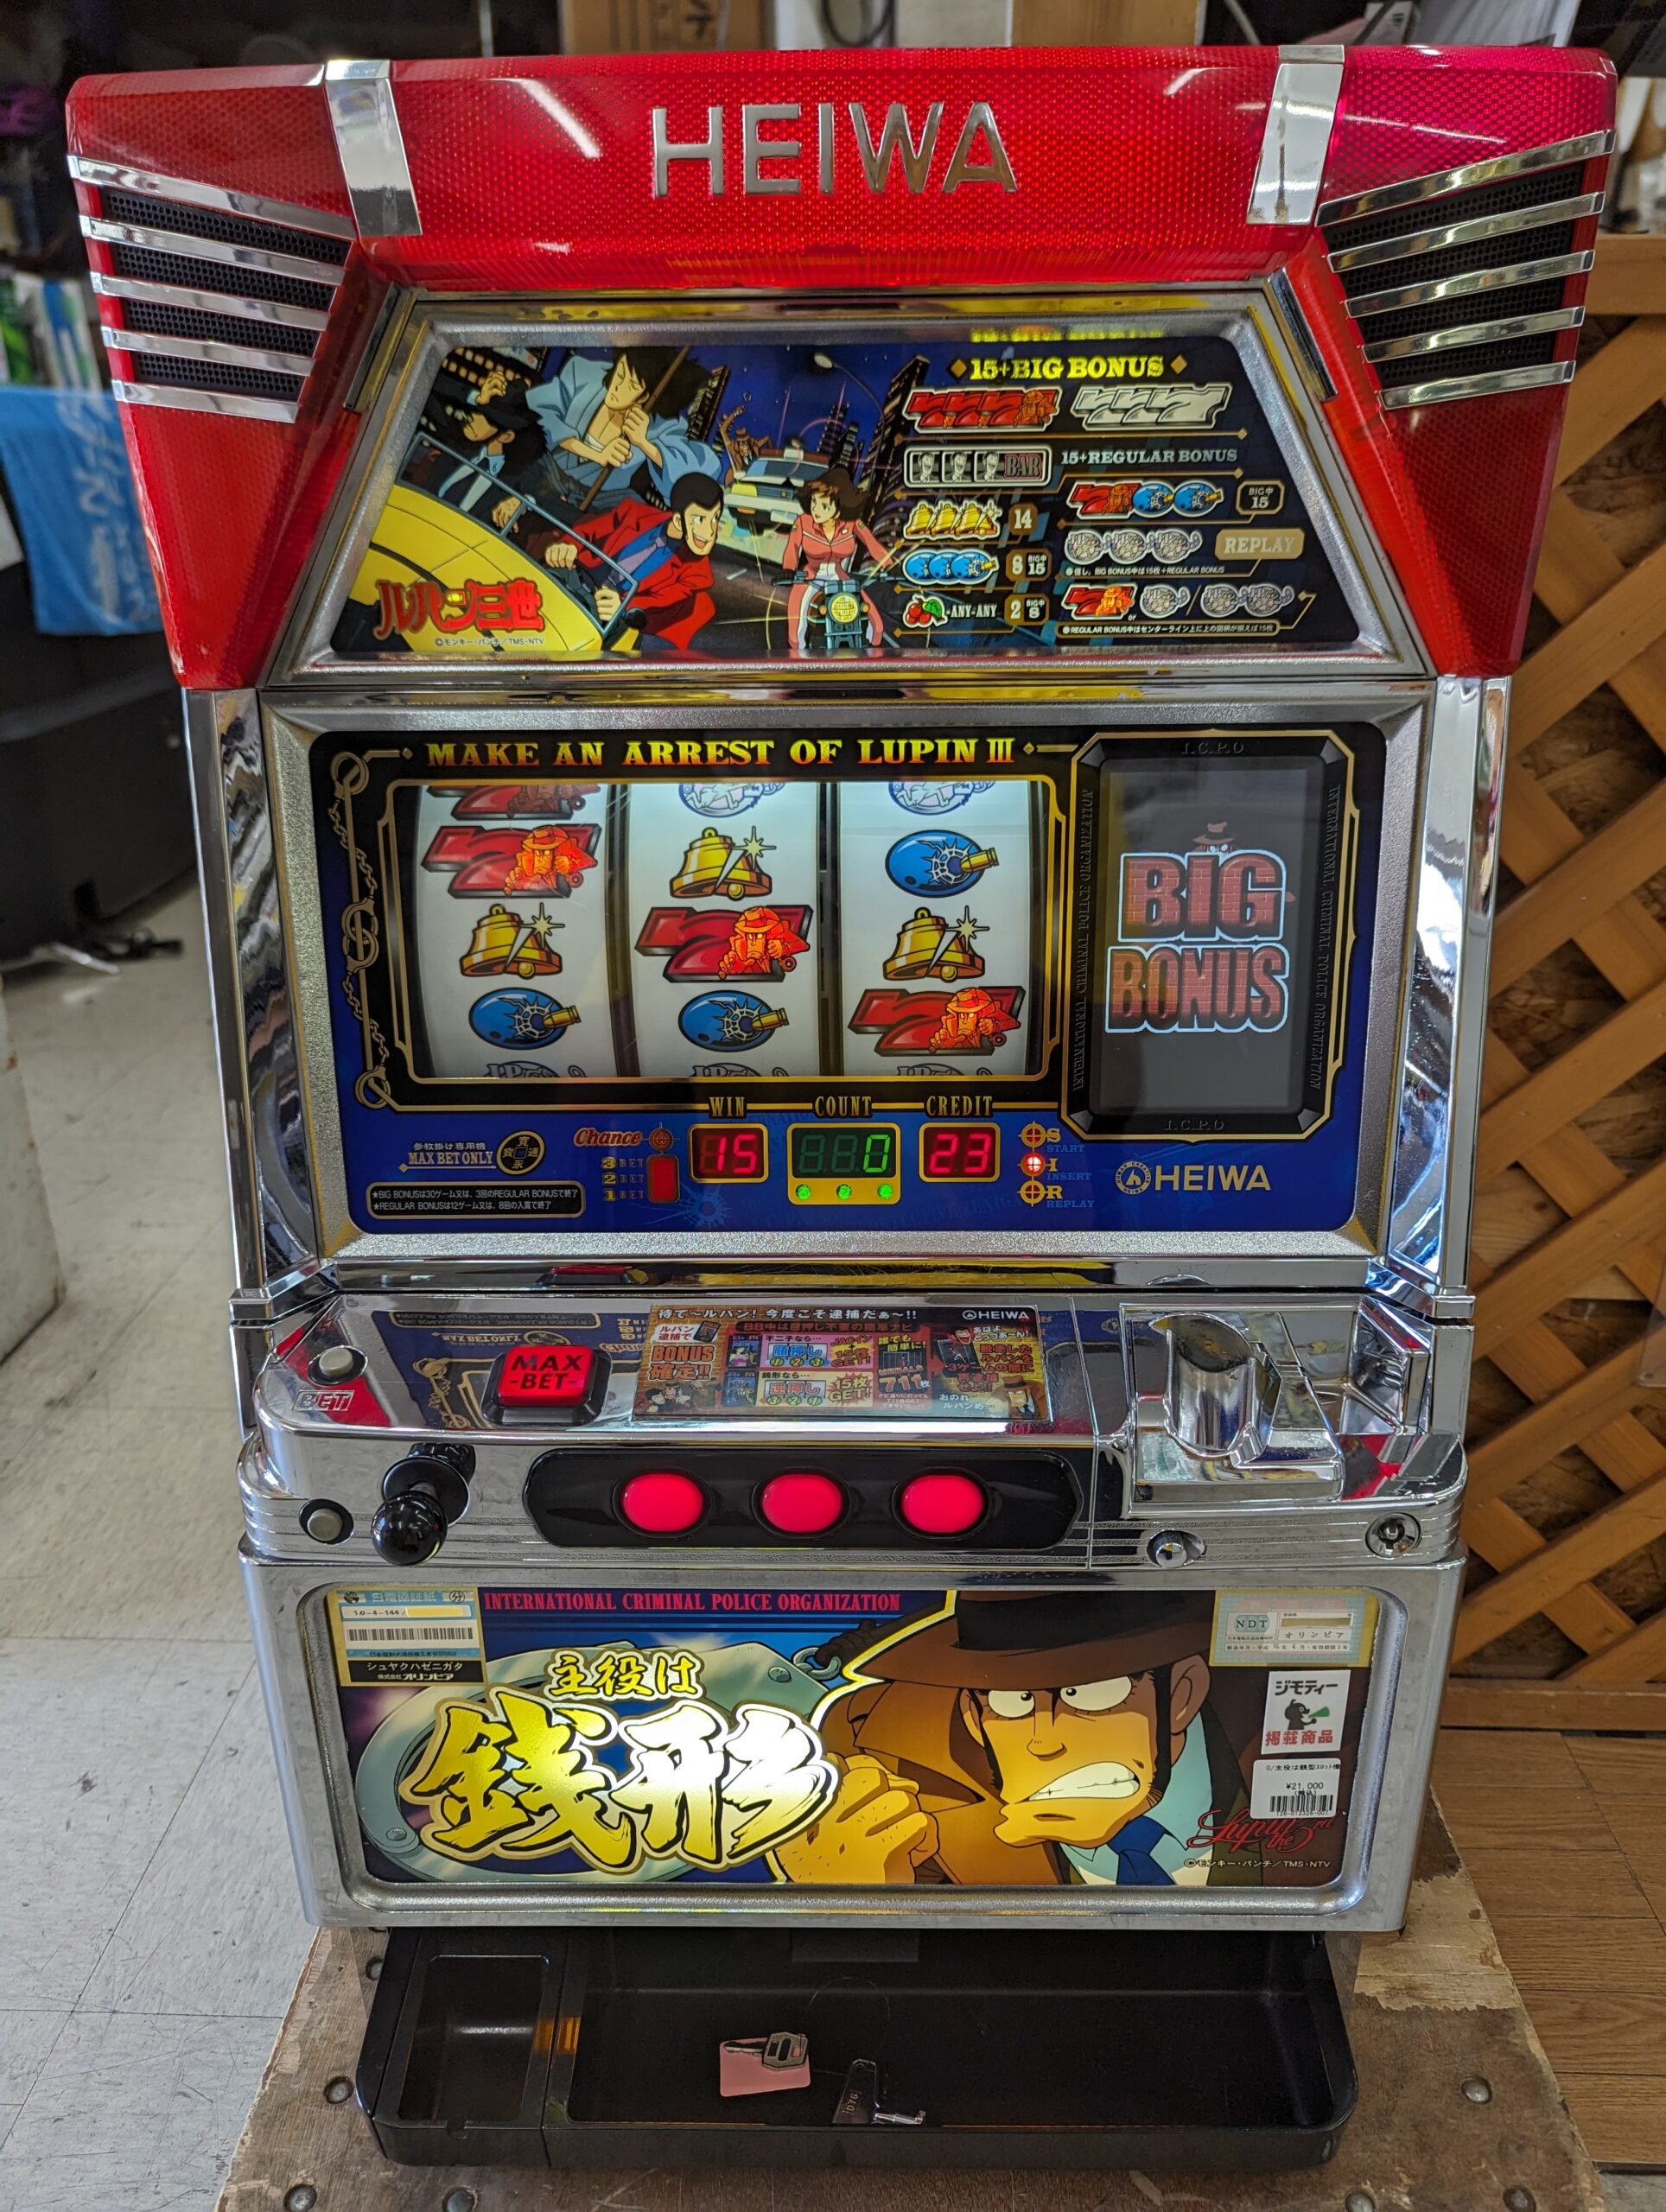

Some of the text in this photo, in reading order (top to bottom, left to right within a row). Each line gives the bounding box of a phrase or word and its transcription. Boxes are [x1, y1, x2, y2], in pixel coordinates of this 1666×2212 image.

[652, 101, 1017, 199] HEIWA
[1067, 355, 1165, 378] BONUS
[1177, 448, 1237, 463] BONUS
[1004, 453, 1042, 480] BAR
[1249, 487, 1274, 496] BIG中
[1252, 497, 1270, 509] 15
[1014, 509, 1033, 529] 14
[1224, 537, 1295, 554] REPLAY
[1012, 555, 1023, 575] 8
[1028, 563, 1046, 575] 15
[1200, 566, 1225, 575] BONUS
[373, 577, 545, 640] ルパン三世
[1010, 601, 1021, 620] 2
[425, 737, 1016, 766] MAKE AN ARREST OF LUPIN III
[1118, 849, 1288, 942] BIG
[1071, 790, 1093, 1091] INTERNATIONAL CRIMINAL POLICE ORGANIZATION
[1309, 785, 1342, 1090] INTERNATIONAL CRIMINAL POLICE ORGANIZATION
[1105, 944, 1289, 1033] BONUS
[709, 1096, 745, 1117] WIN
[815, 1096, 872, 1116] COUNT
[926, 1096, 993, 1116] CREDIT
[574, 1128, 644, 1147] Chance
[1046, 1128, 1061, 1143] S
[408, 1151, 493, 1165] MAX BET ONLY
[715, 1134, 757, 1173] 15
[928, 1133, 992, 1173] 23
[1046, 1145, 1085, 1154] START
[601, 1156, 644, 1170] 3 BET
[602, 1172, 644, 1185] 2 BET
[1046, 1173, 1092, 1181] INSERT
[1154, 1165, 1272, 1192] HEIWA
[603, 1188, 644, 1201] 1 BET
[1046, 1185, 1063, 1199] R
[1046, 1200, 1095, 1209] REPLAY
[978, 1311, 1030, 1319] HEIWA
[652, 1345, 715, 1362] BONUS
[773, 1345, 823, 1357] 順押し
[511, 1354, 584, 1372] MAX
[830, 1356, 871, 1367] GET!
[298, 1390, 352, 1410] BET
[829, 1387, 871, 1402] GET!
[484, 1592, 900, 1611] INTERNATIONAL CRIMINAL POLICE ORGANIZATION
[1236, 1619, 1269, 1629] NDT
[367, 1662, 463, 1671] シュヤクハゼニガタ
[549, 1652, 700, 1699] 主役は
[1275, 1680, 1339, 1696] ジモティー
[1265, 1729, 1334, 1746] 掲載商品
[1265, 1832, 1294, 1850] the
